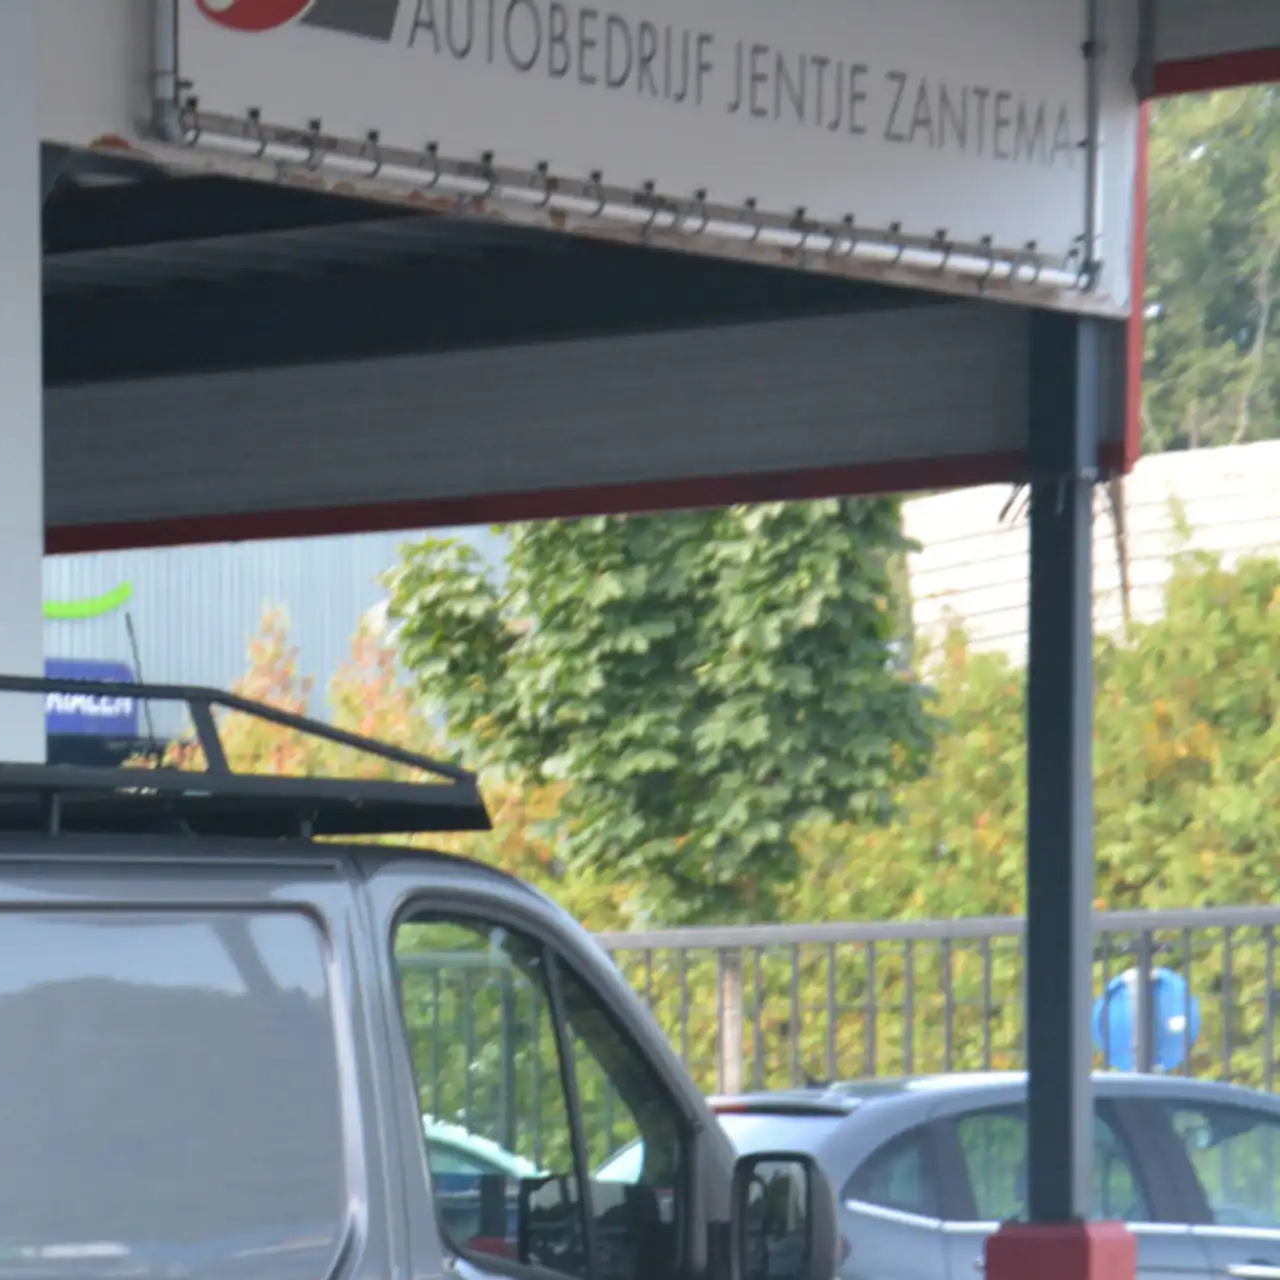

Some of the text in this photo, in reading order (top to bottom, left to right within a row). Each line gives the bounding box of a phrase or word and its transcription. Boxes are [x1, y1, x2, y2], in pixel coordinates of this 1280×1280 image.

[407, 0, 1077, 169] AUTOBEDRIJF JENTJE ZANTEMA
